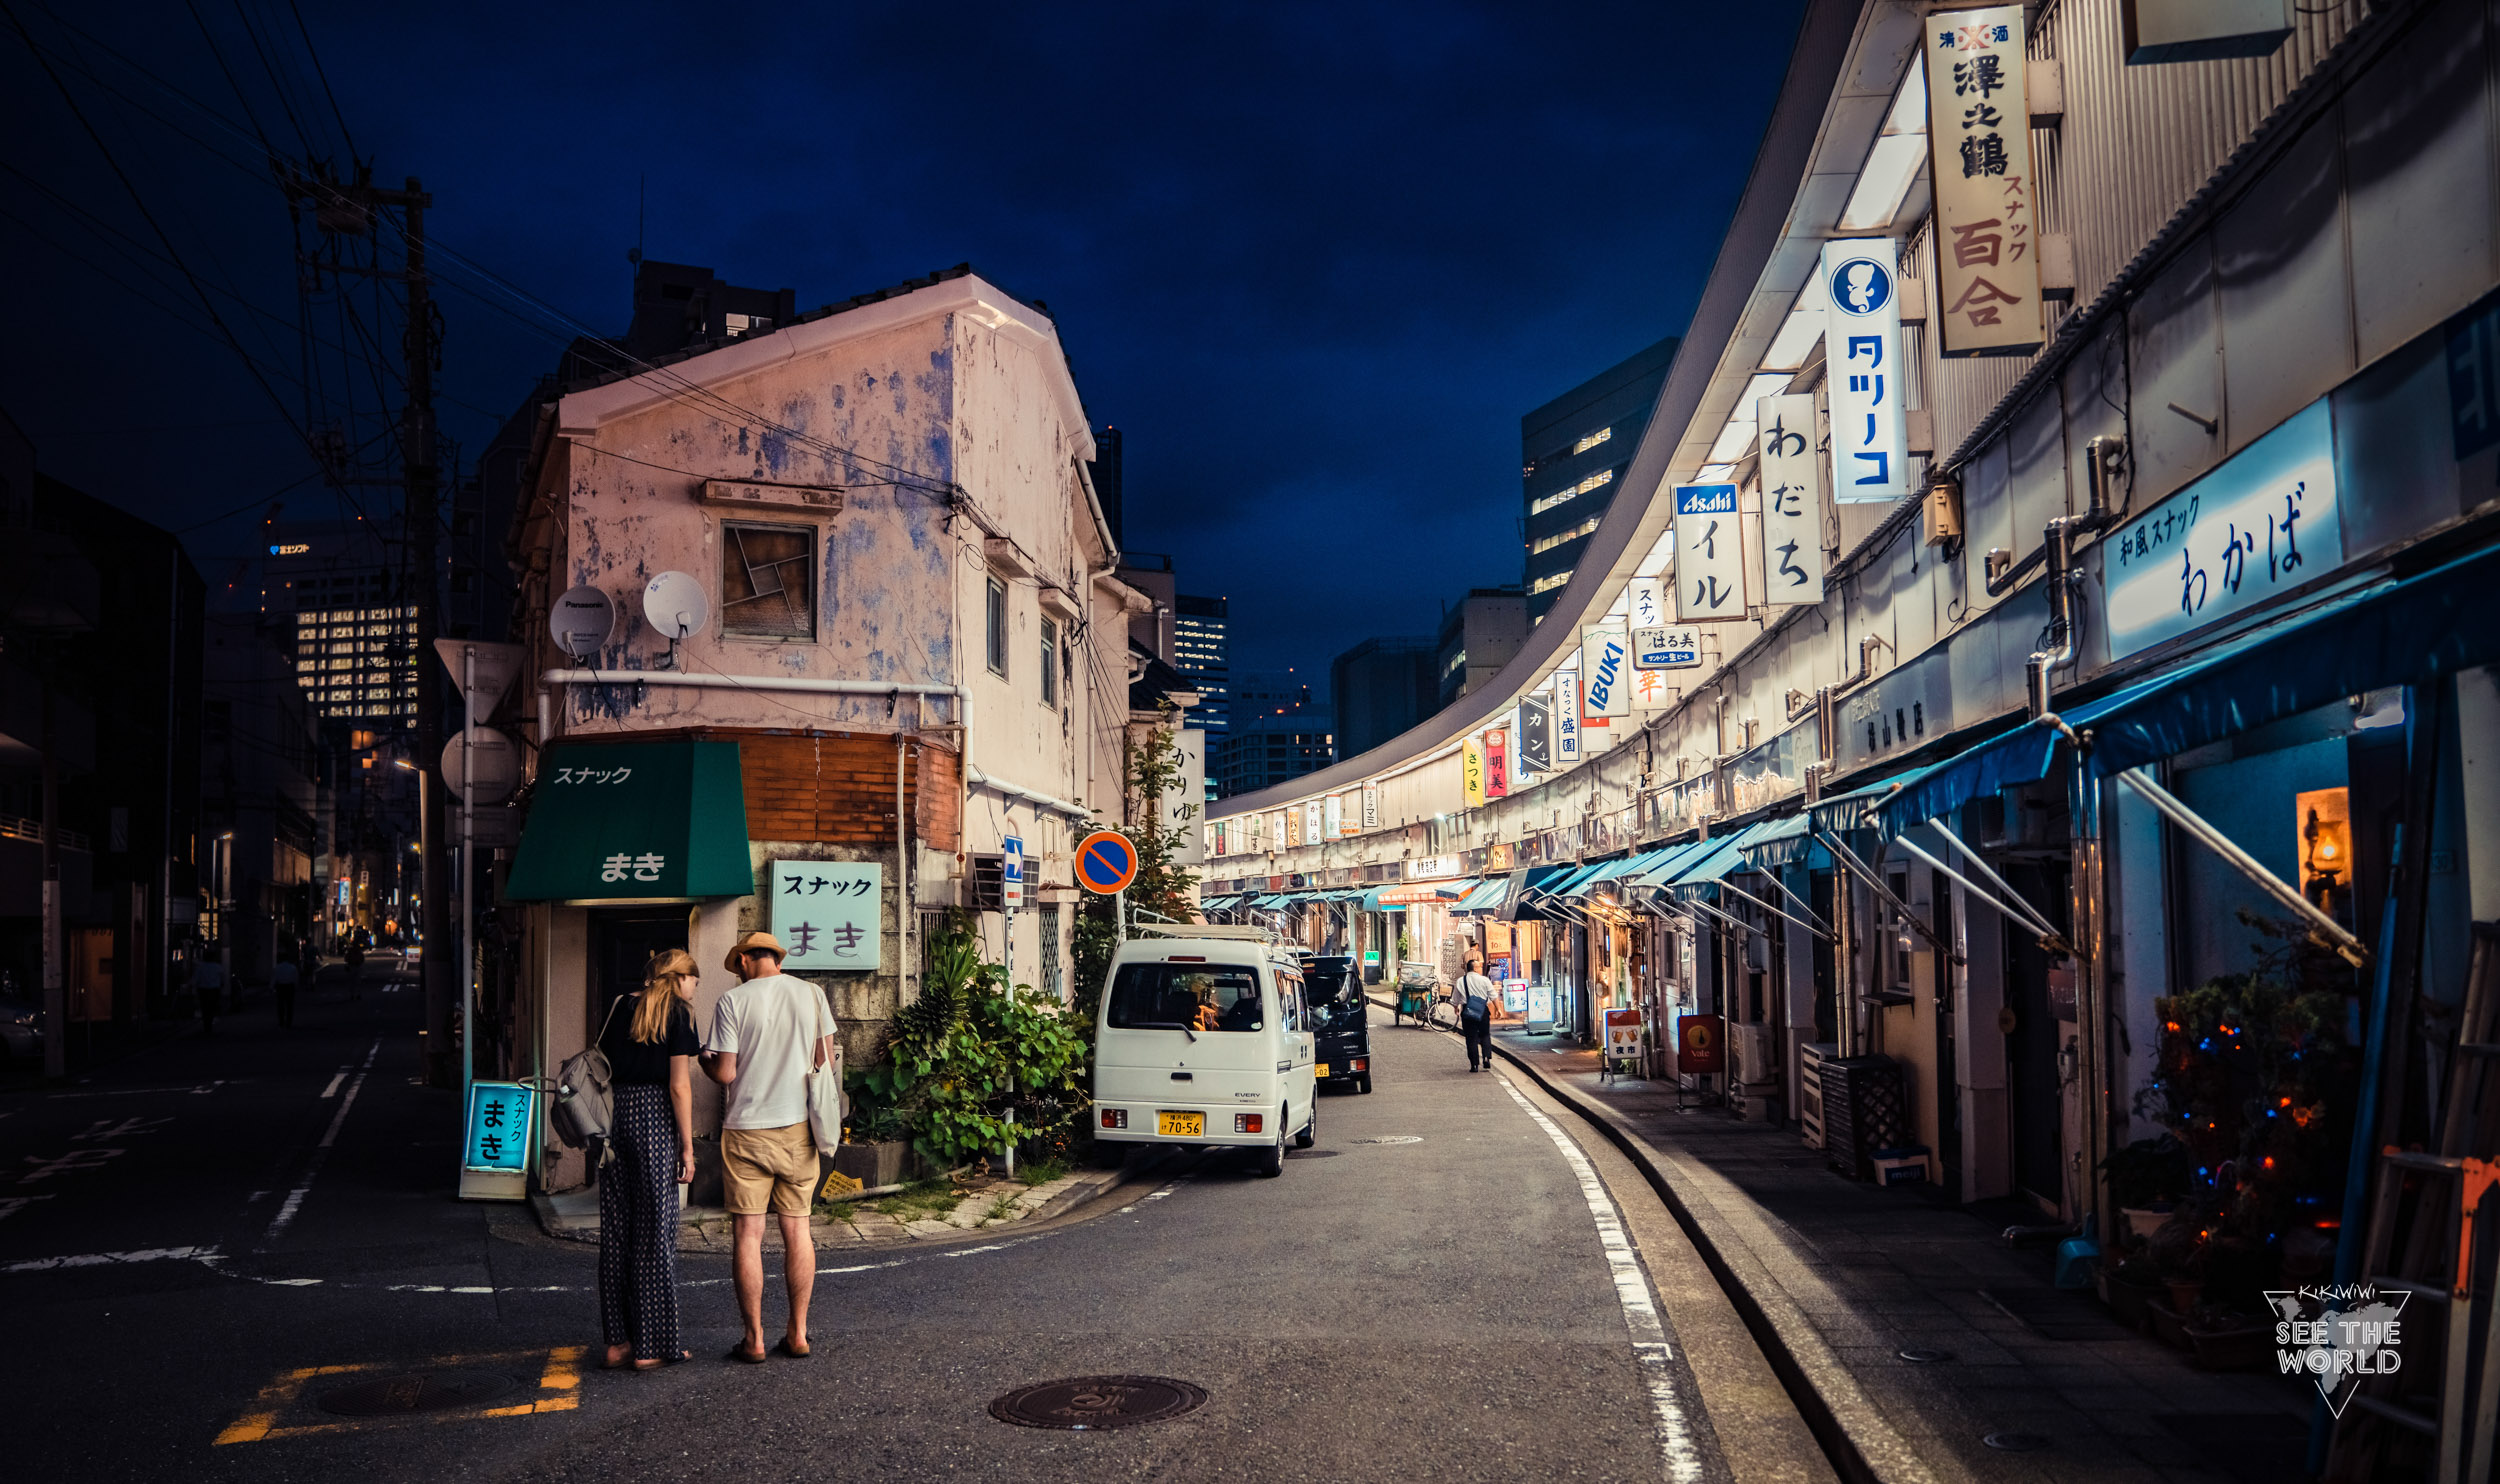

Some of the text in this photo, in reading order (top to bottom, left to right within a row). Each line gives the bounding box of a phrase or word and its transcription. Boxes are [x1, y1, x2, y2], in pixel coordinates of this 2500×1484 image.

[2003, 176, 2028, 262] スナック
[1947, 219, 2022, 327] 百合
[1848, 335, 1889, 486] タツノコ
[1683, 492, 1731, 513] Asahi
[1764, 413, 1809, 587] わだち
[2119, 494, 2200, 567] 和風スナック
[2180, 481, 2306, 617] わかば
[1691, 520, 1732, 609] イル
[1562, 677, 1571, 715] すなっく
[1588, 641, 1624, 711] IBUKI
[554, 767, 632, 784] スナック
[1467, 753, 1479, 791] さつき
[1489, 755, 1505, 789] 明美
[601, 852, 664, 882] まき
[783, 876, 872, 896] スナック
[787, 921, 866, 957] まき
[1616, 1046, 1636, 1054] 夜市
[481, 1100, 504, 1160] まき
[511, 1094, 525, 1142] スナック
[1168, 1121, 1199, 1133] 70-56
